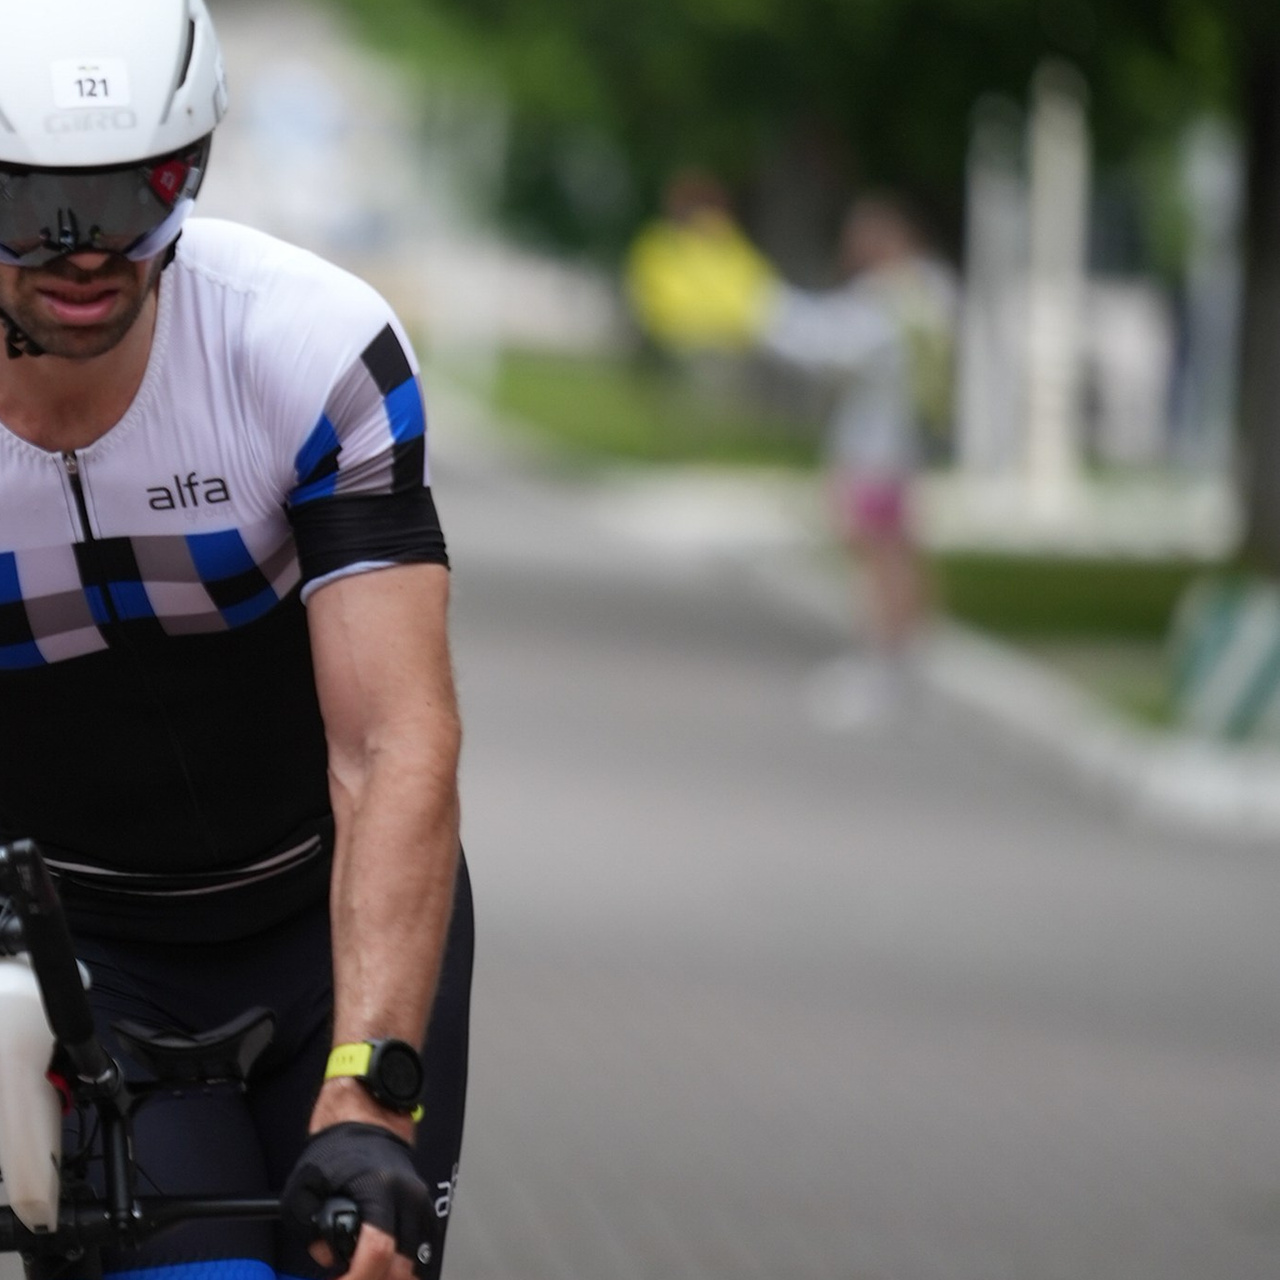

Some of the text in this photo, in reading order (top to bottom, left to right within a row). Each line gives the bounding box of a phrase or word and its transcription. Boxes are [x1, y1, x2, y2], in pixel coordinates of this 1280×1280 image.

[75, 78, 109, 97] 121
[43, 109, 138, 134] GIRO
[146, 472, 230, 510] alfa
